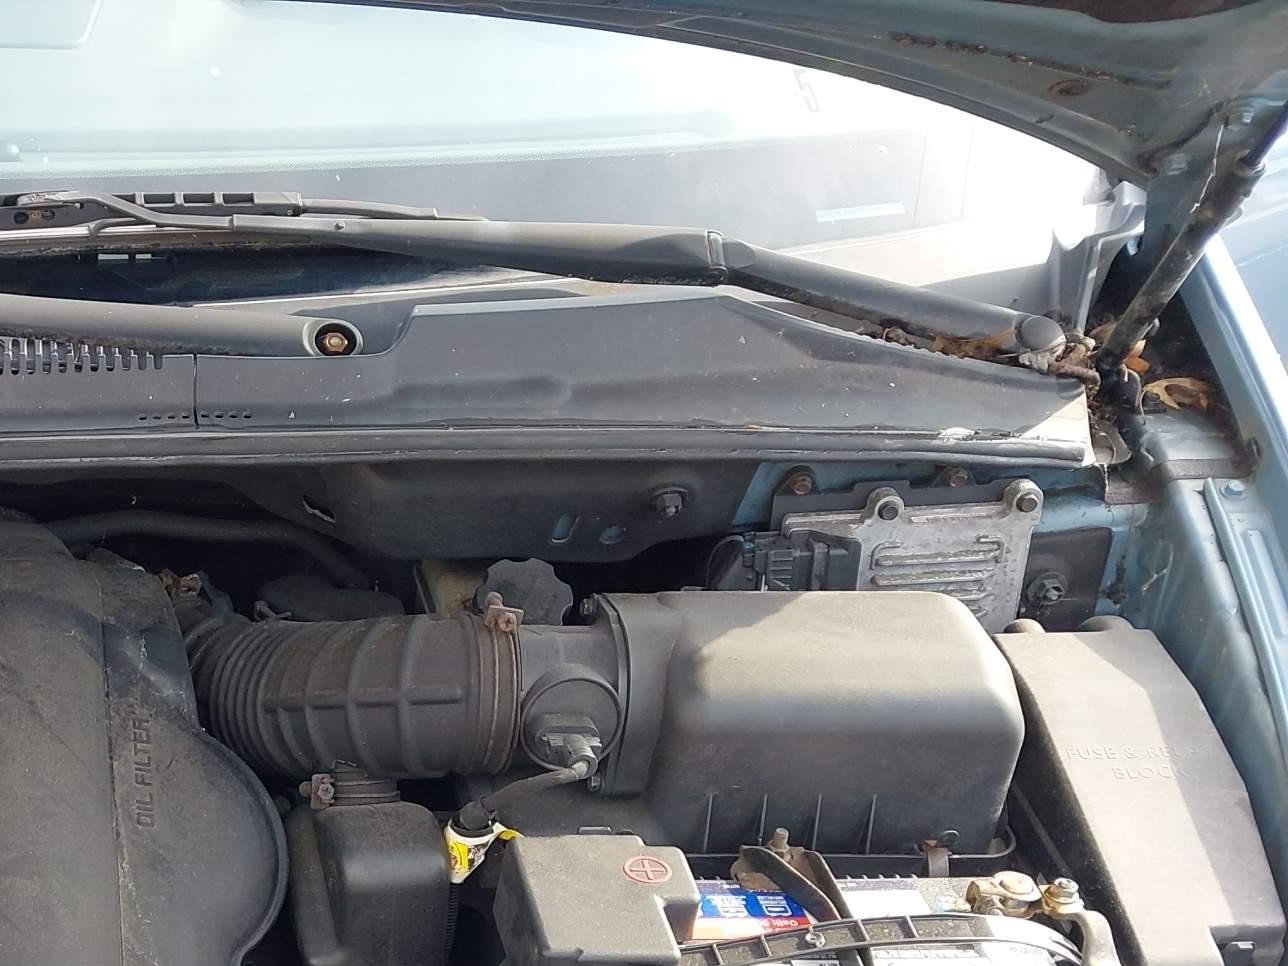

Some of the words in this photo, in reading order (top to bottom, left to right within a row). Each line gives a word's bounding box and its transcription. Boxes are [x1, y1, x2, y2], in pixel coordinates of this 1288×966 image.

[132, 718, 153, 787] FILTER
[1065, 745, 1120, 760] FUSE
[1122, 744, 1138, 759] &
[135, 791, 154, 829] OIL
